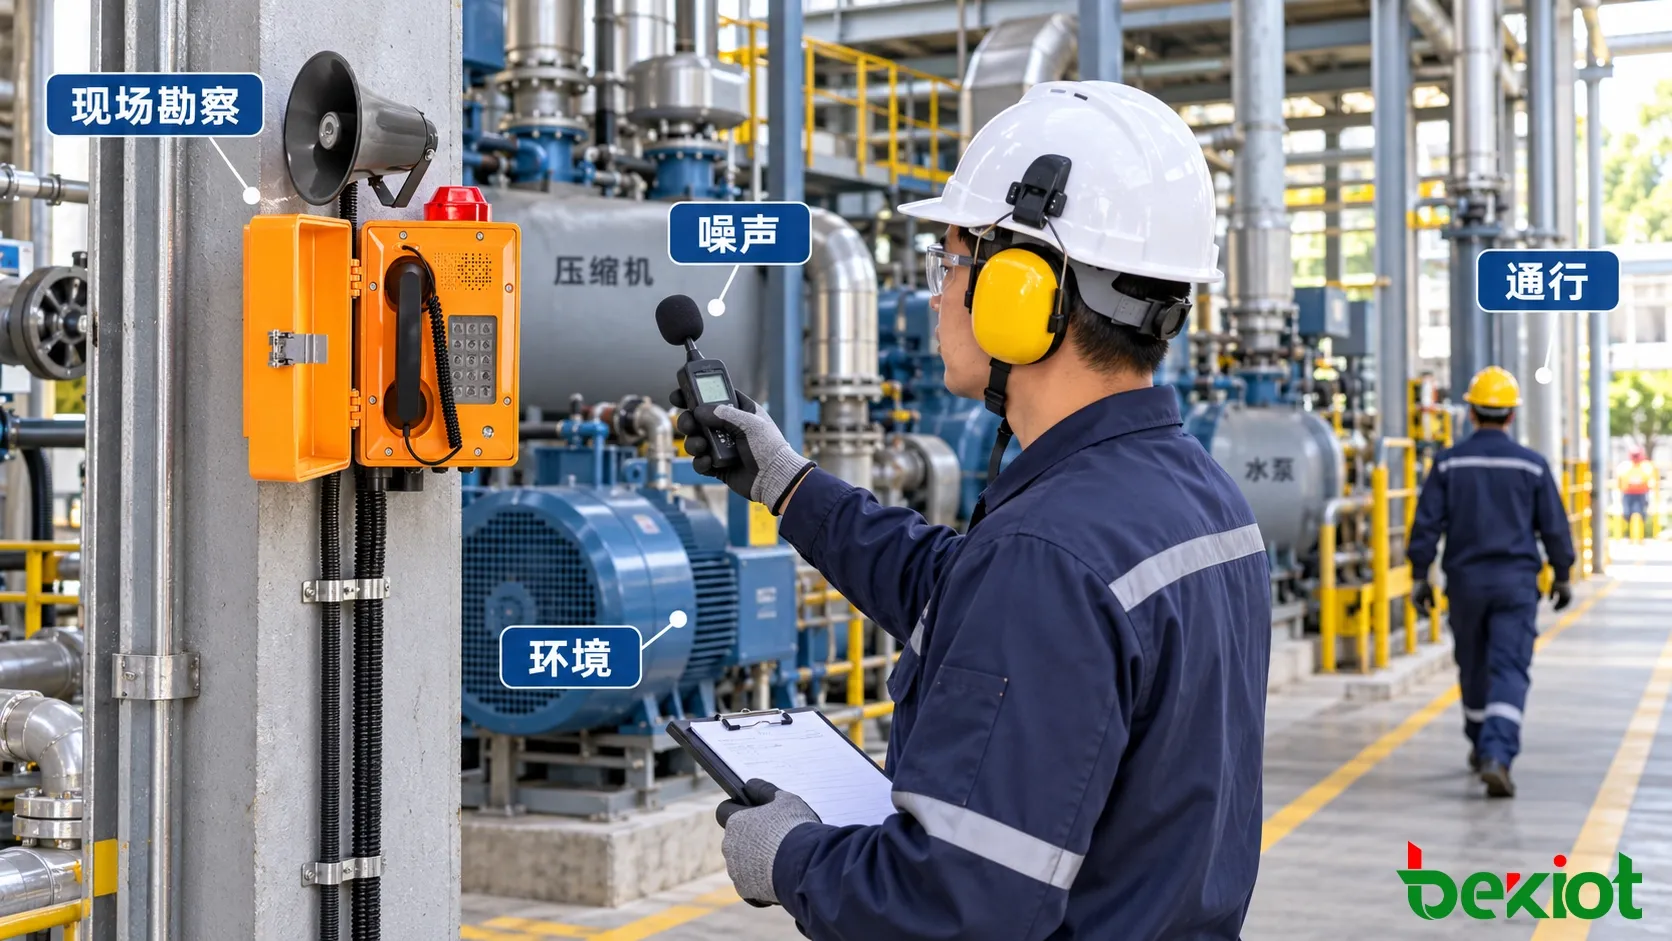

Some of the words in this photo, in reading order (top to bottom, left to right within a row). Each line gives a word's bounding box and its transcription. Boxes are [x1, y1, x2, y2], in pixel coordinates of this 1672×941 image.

[554, 255, 655, 287] 压缩机
[1245, 457, 1295, 482] 水泵
